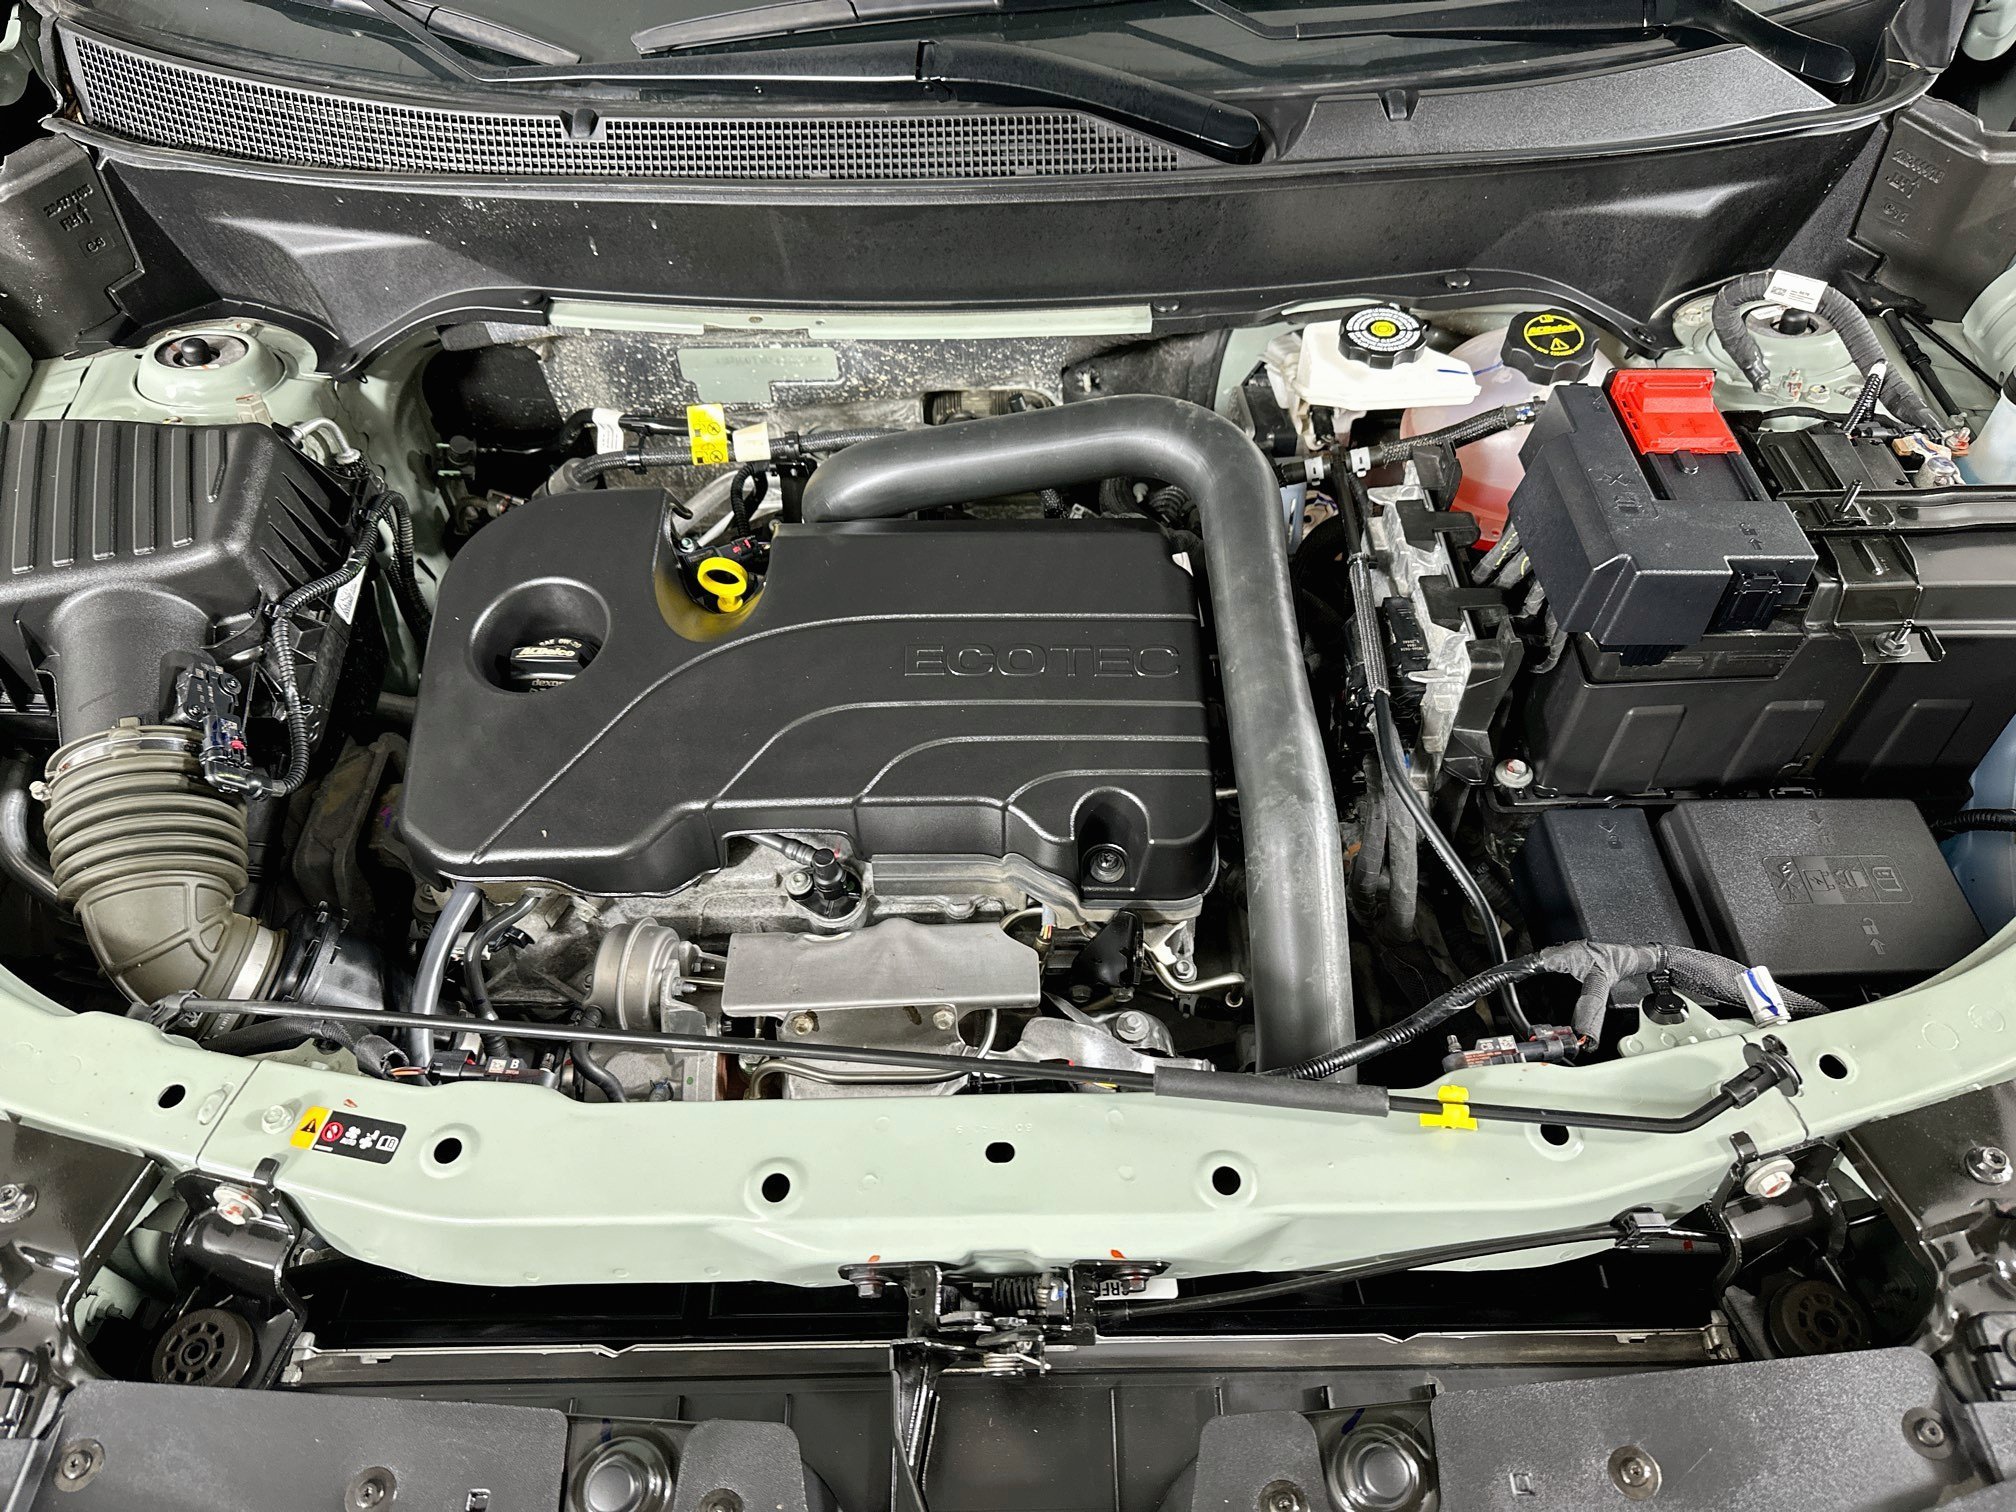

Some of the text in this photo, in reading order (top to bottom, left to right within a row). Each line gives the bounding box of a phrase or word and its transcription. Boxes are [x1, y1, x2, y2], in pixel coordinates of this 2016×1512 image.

[519, 647, 576, 656] ACDelco
[904, 643, 1180, 678] ECOTEC
[510, 1059, 520, 1069] B
